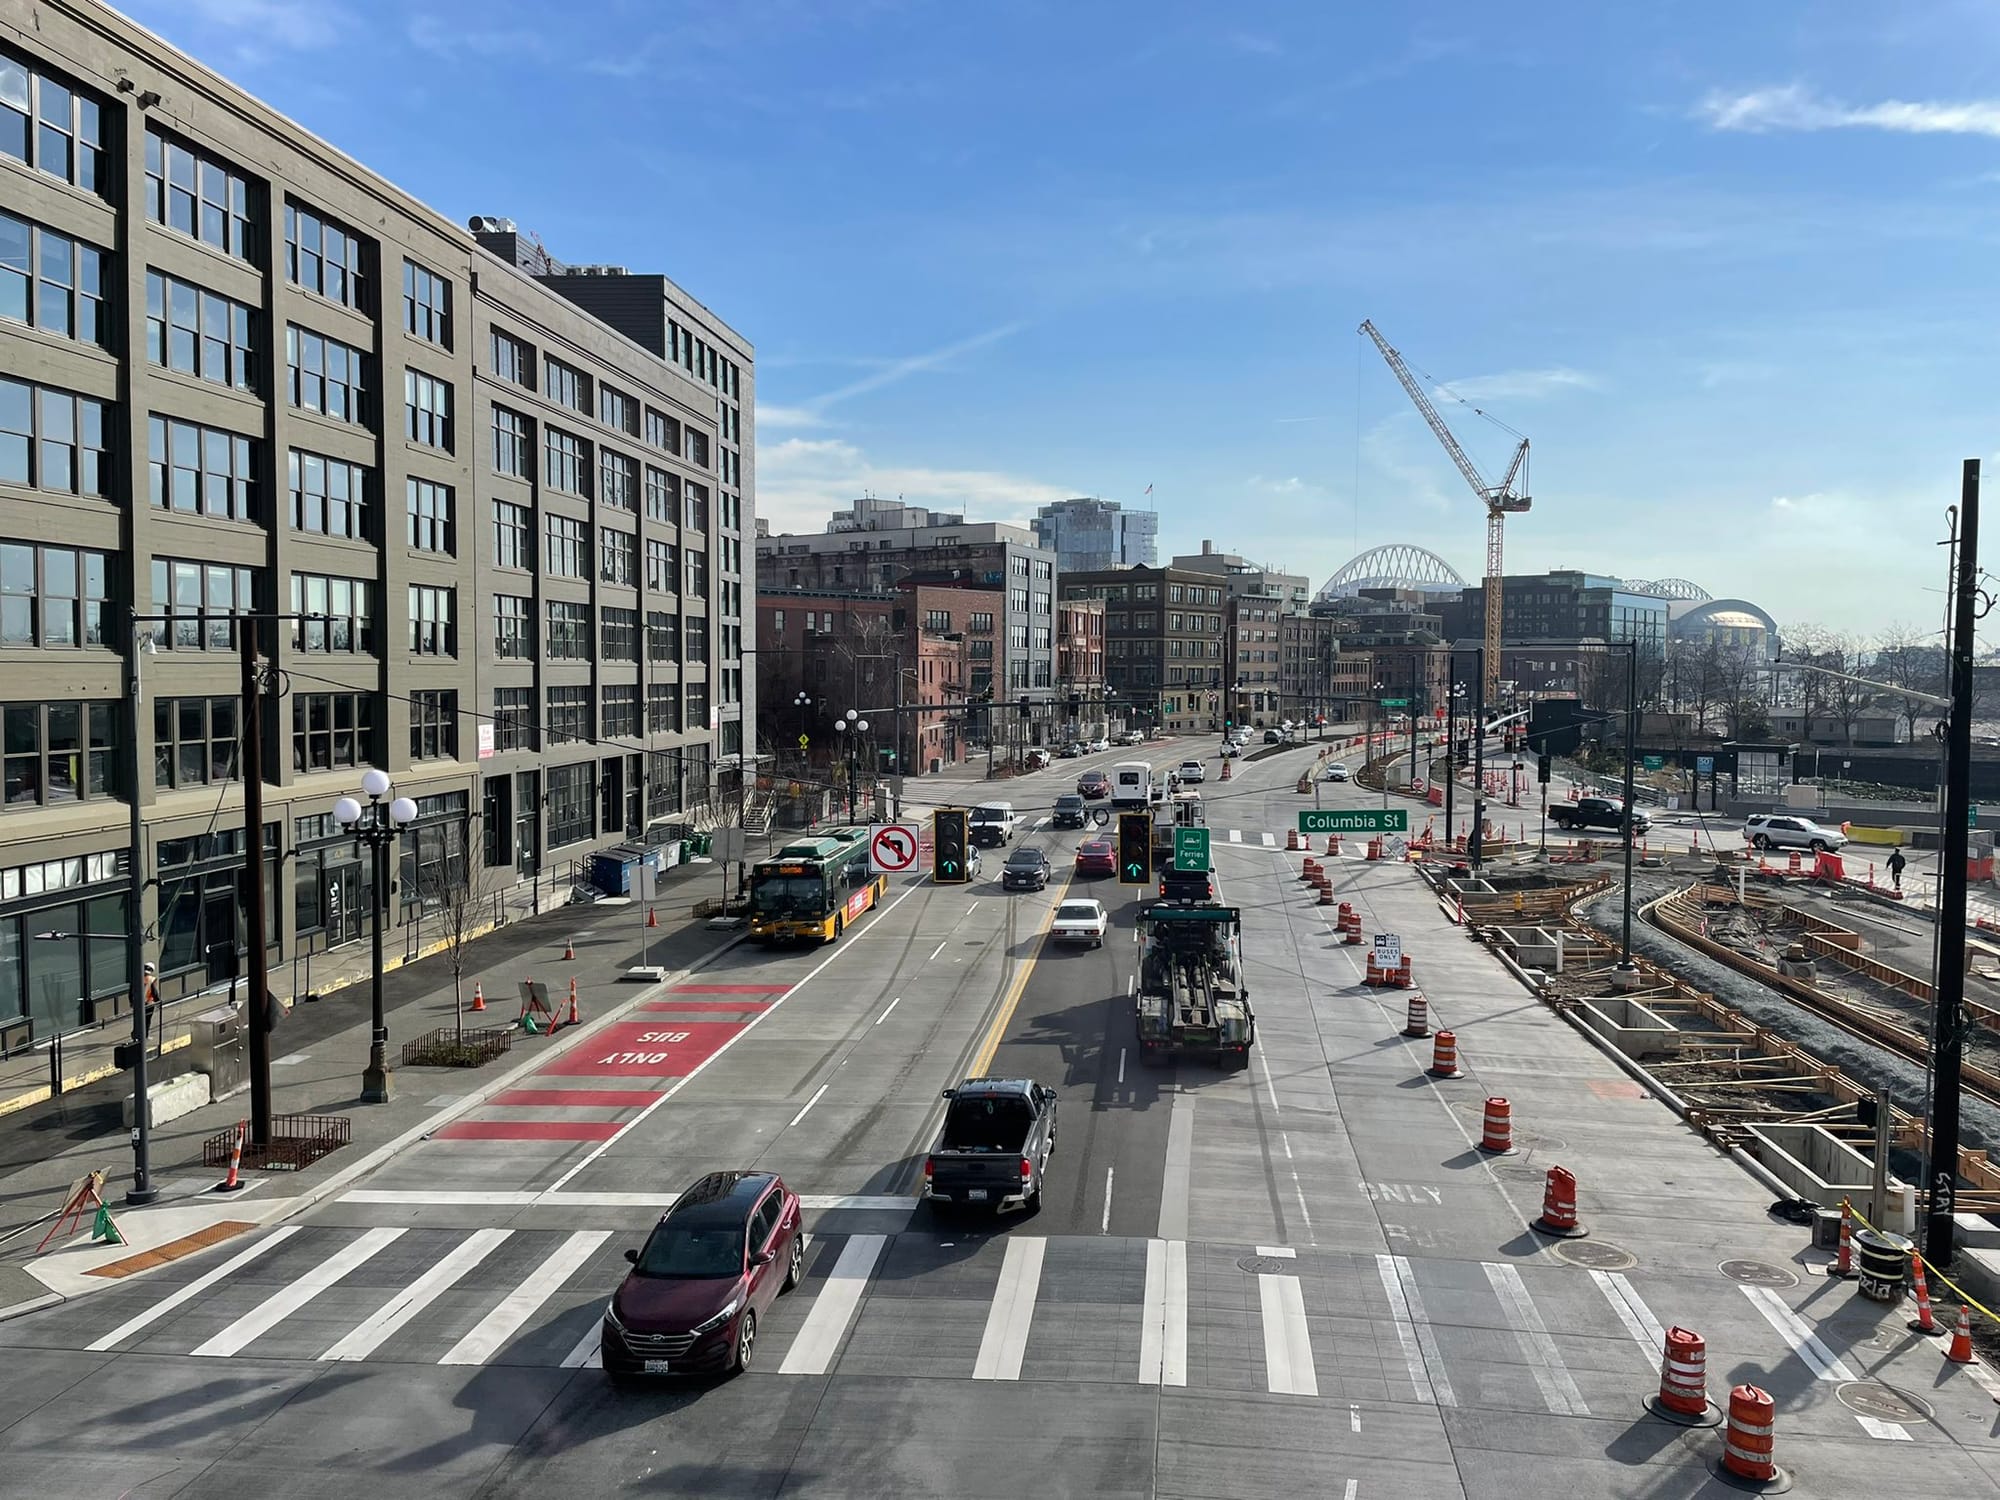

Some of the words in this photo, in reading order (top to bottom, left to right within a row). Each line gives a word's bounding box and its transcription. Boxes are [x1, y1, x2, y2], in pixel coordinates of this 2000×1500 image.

[1306, 815, 1376, 829] Columbia
[1384, 814, 1400, 827] St
[1179, 850, 1204, 858] Ferries
[636, 1031, 691, 1043] BUS
[597, 1052, 669, 1064] ONLY
[1932, 1172, 1953, 1216] STAY
